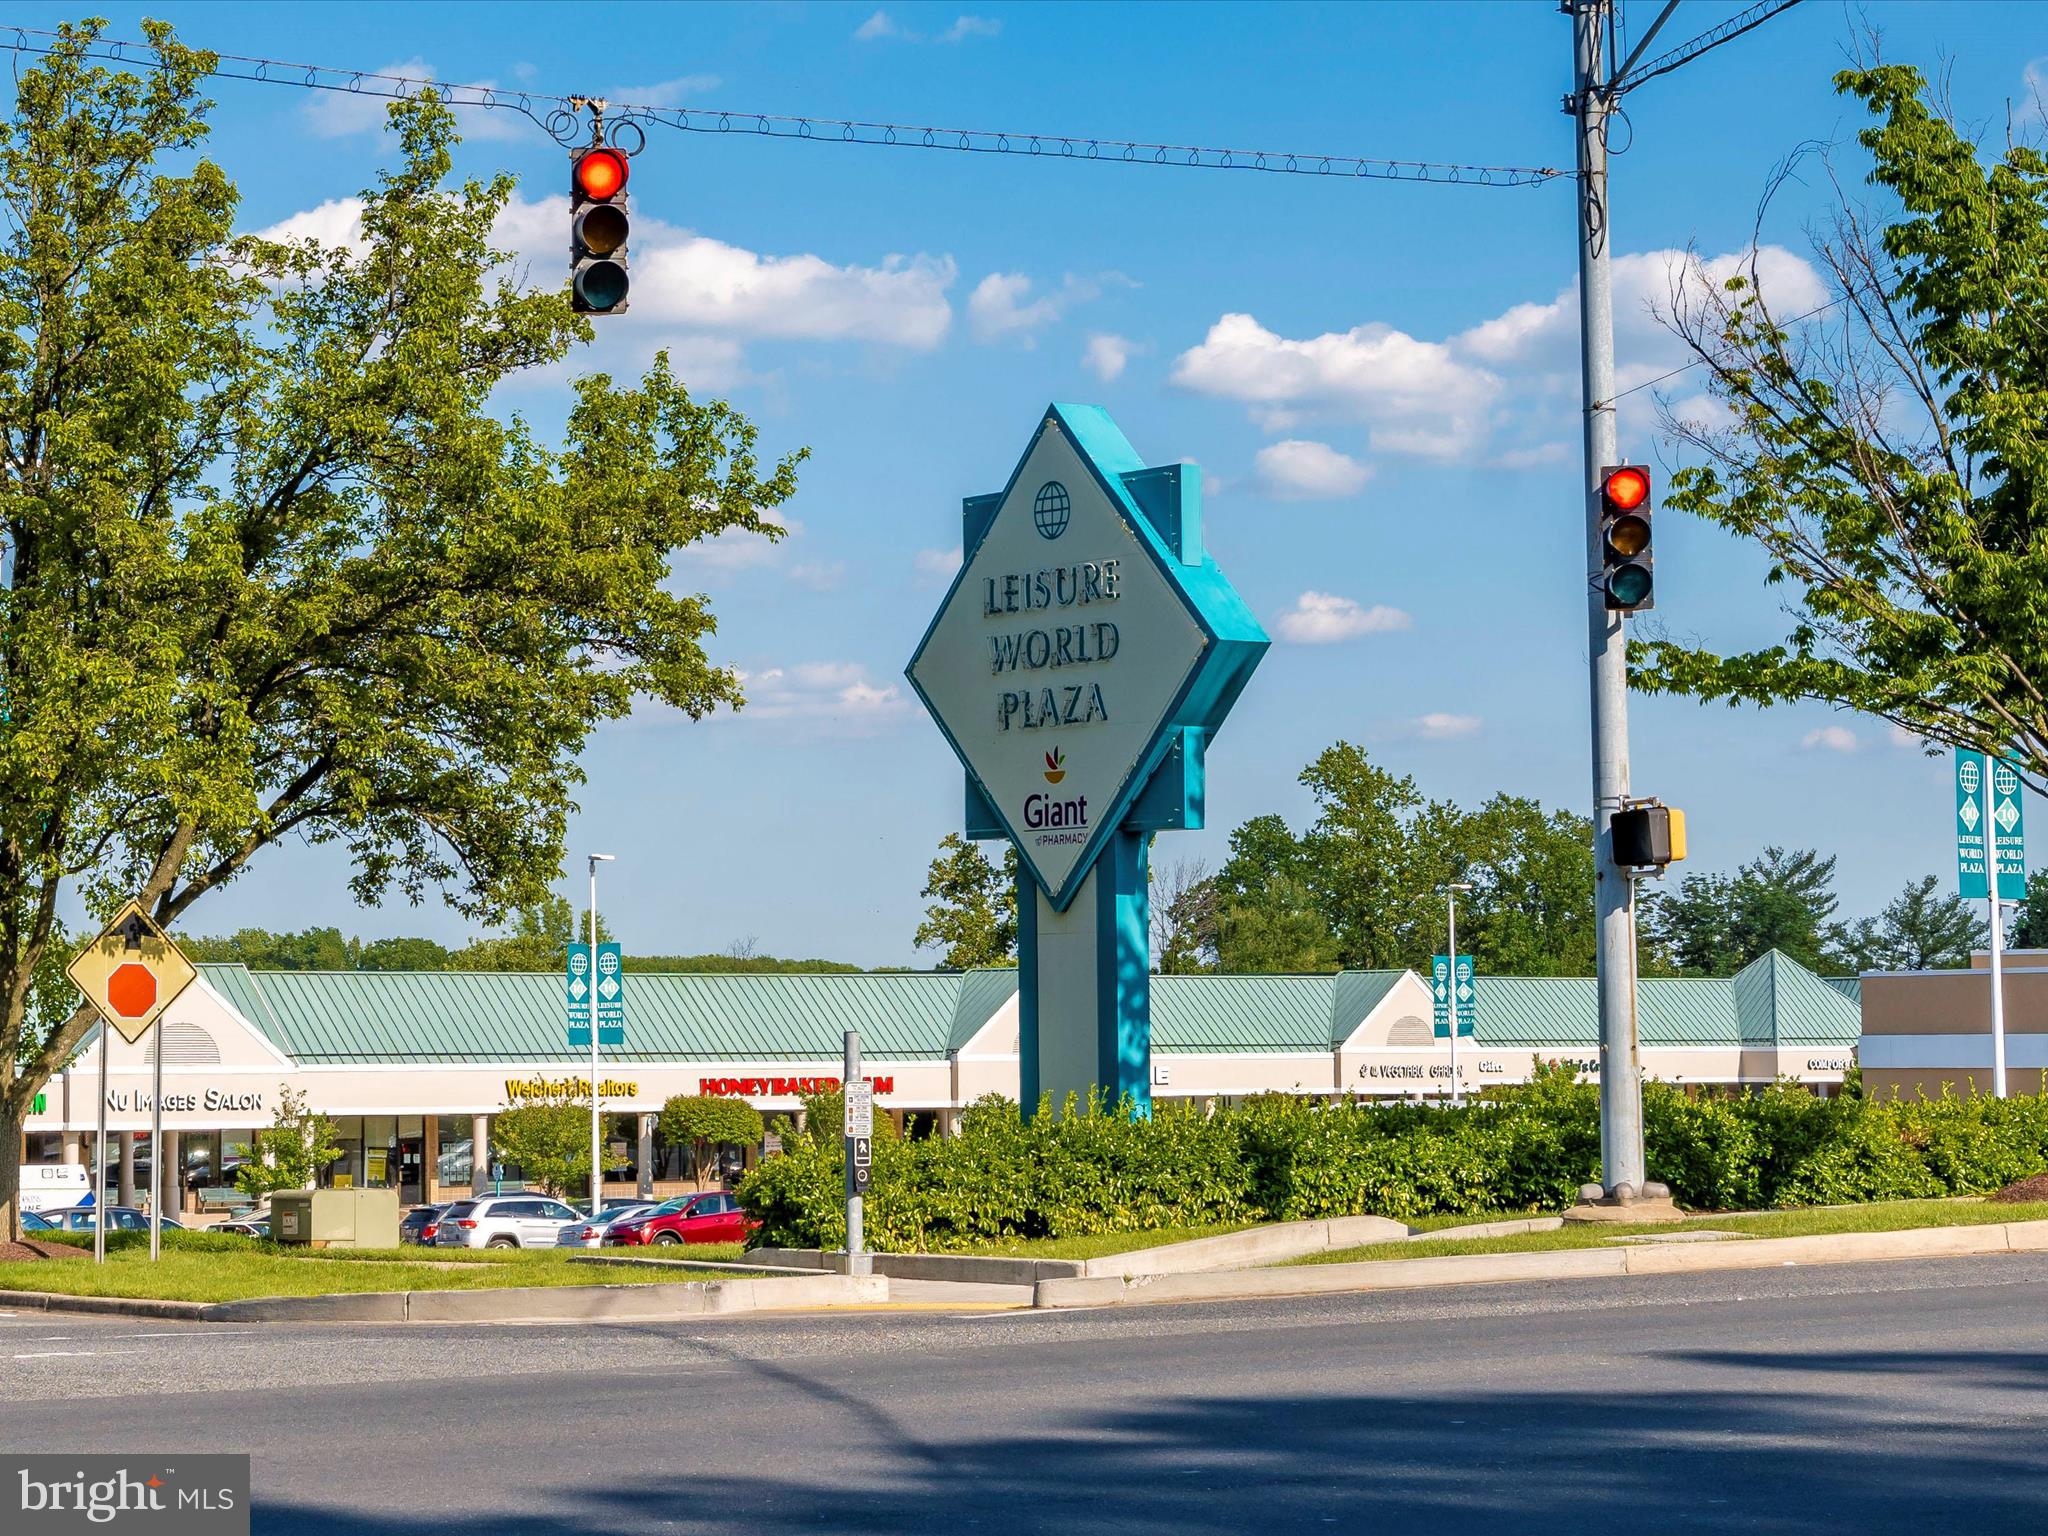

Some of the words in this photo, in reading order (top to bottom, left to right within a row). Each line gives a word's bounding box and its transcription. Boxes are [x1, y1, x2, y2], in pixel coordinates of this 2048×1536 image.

[984, 559, 1120, 617] LEISURE
[988, 622, 1120, 675] WORLD
[998, 682, 1108, 732] PLAZA
[1024, 793, 1088, 829] Giant
[2002, 808, 2016, 821] 10
[1042, 832, 1088, 847] PHARMACY
[1958, 836, 1982, 844] LEISURE
[1960, 848, 1983, 858] WORLD
[1960, 862, 1984, 874] PLAZA
[1996, 864, 2023, 874] PLAZA
[1429, 1064, 1463, 1079] GARDN
[699, 1077, 843, 1097] HONEYBAKED
[204, 1087, 263, 1111] SALON
